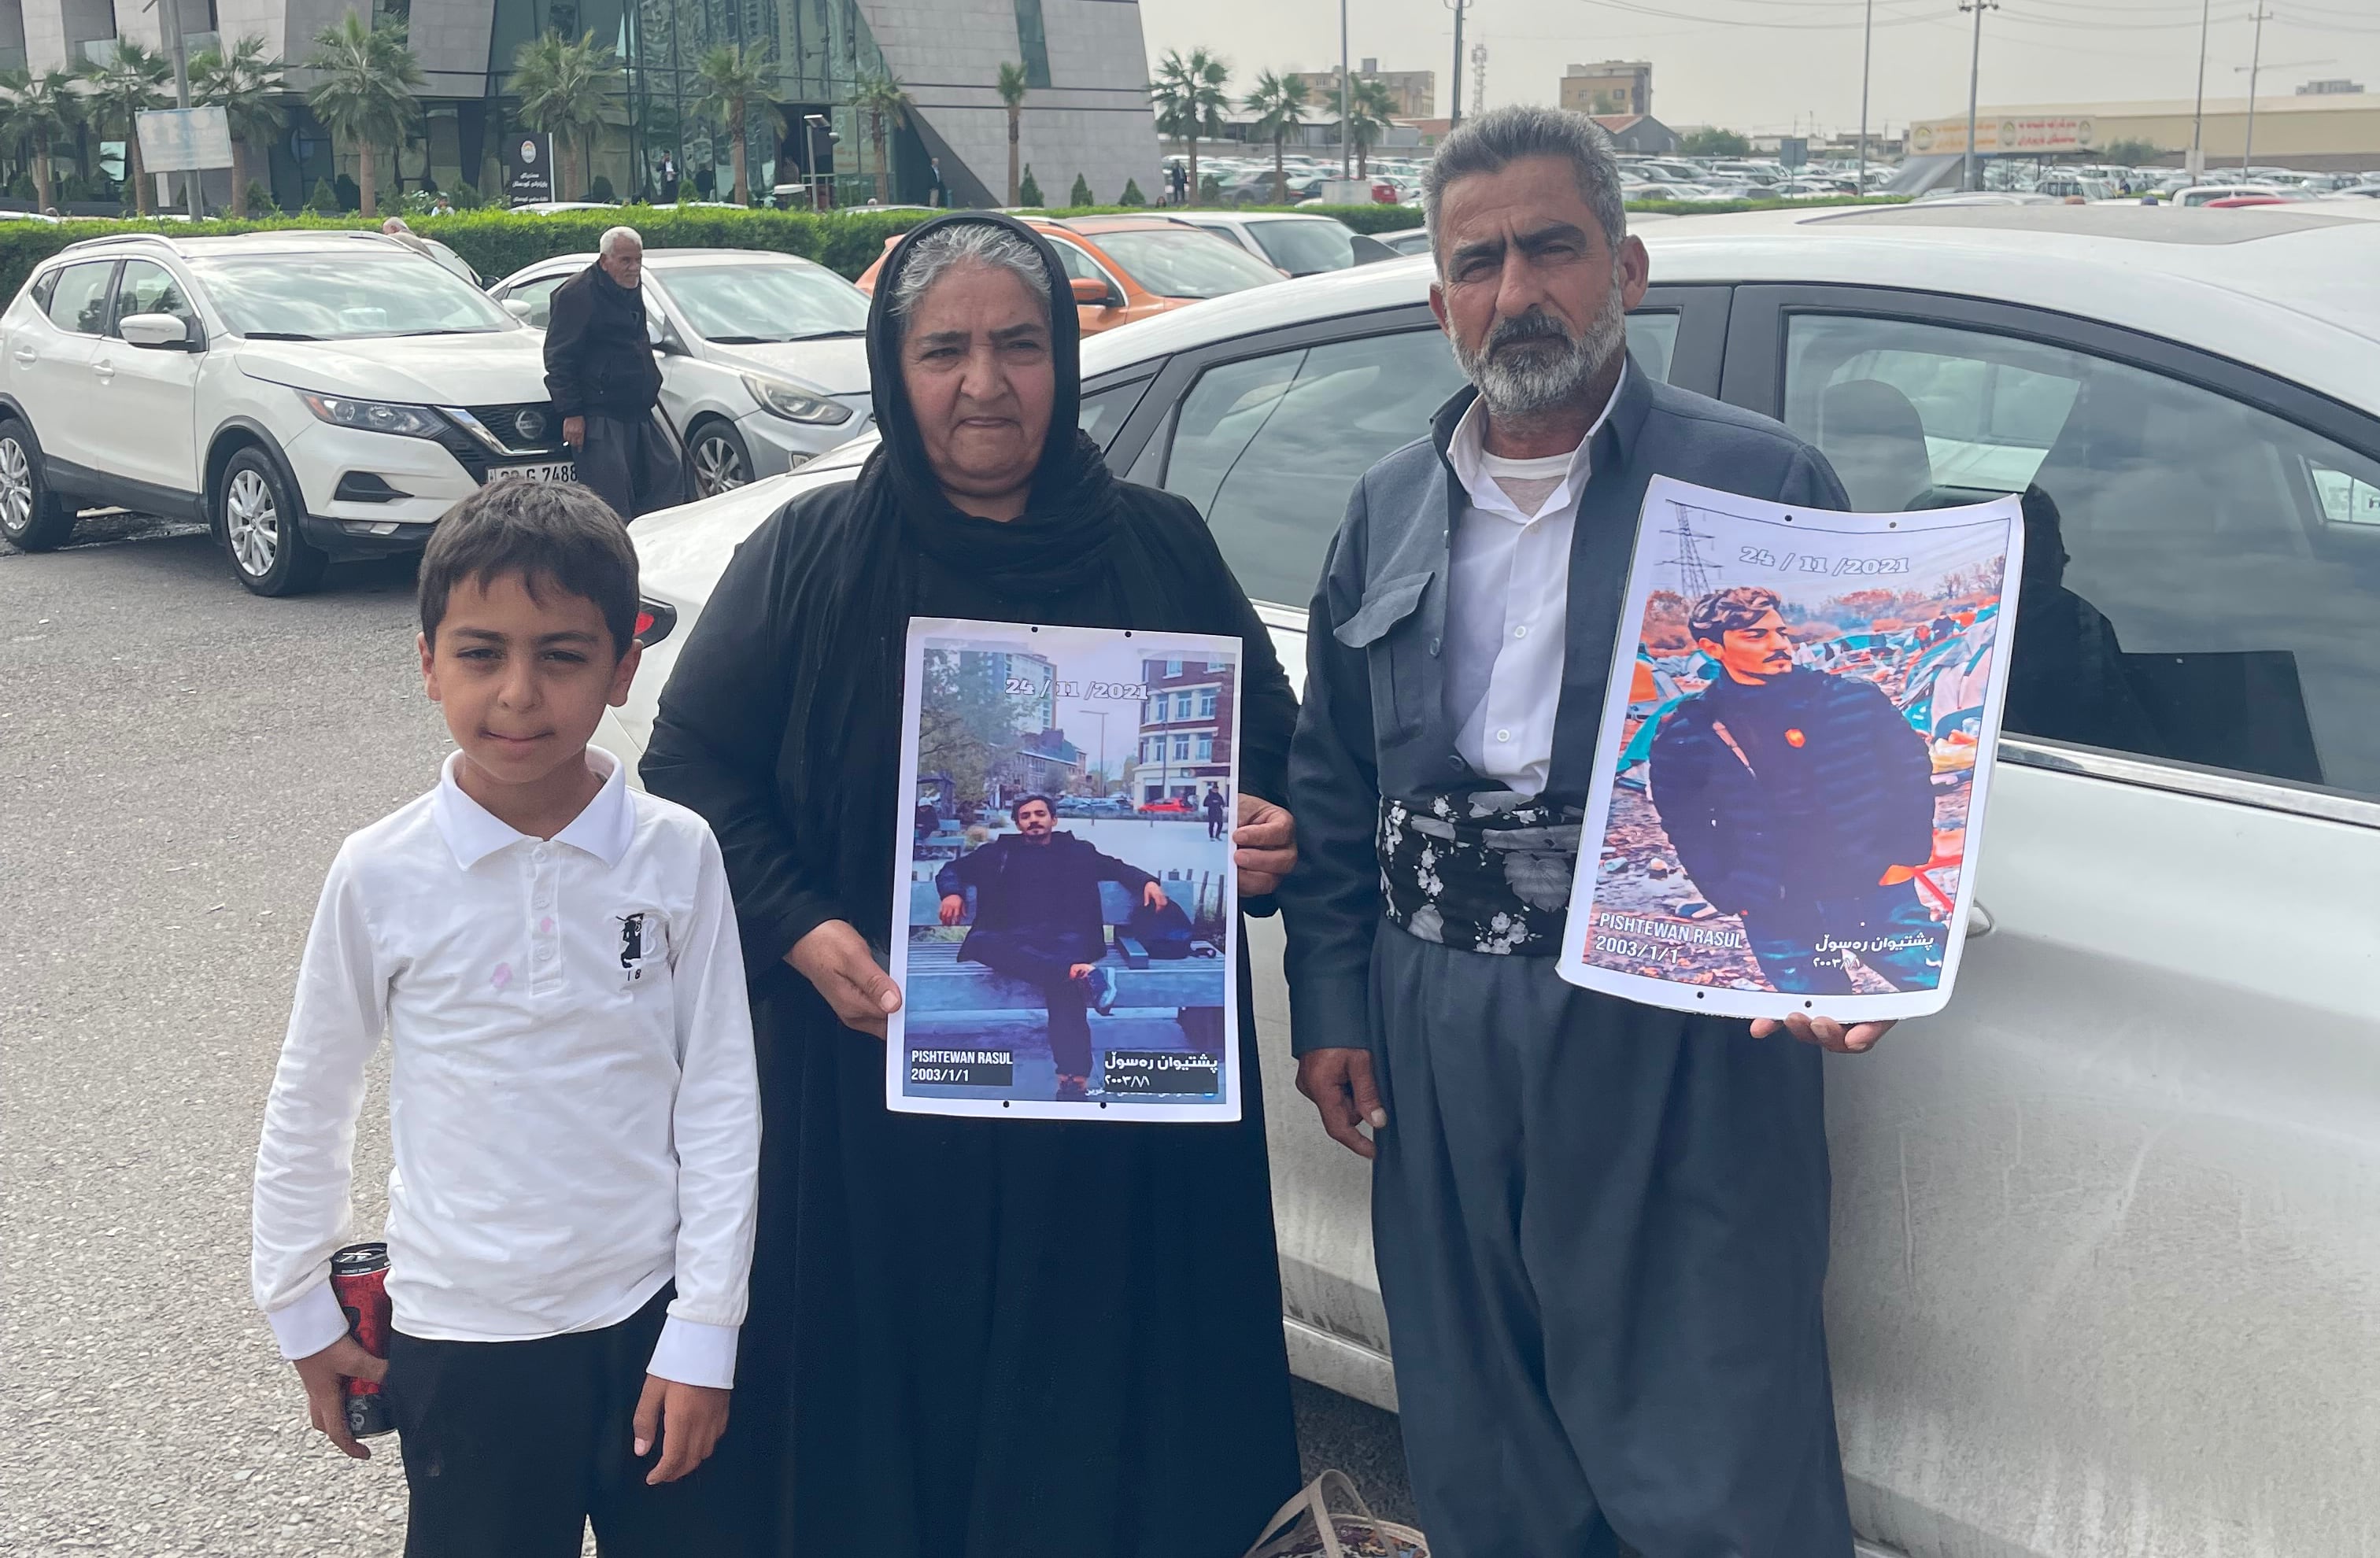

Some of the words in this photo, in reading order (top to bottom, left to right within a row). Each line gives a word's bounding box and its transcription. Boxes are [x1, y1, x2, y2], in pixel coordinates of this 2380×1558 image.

[542, 465, 577, 482] 7488
[1739, 546, 1776, 567] 24
[1779, 552, 1796, 571] /
[1799, 556, 1828, 574] 11
[1005, 678, 1035, 695] 24
[1040, 678, 1051, 699] /
[1055, 681, 1080, 697] 11
[1598, 912, 1690, 942] PISHTEWAN
[1693, 928, 1744, 949] RASUL
[1595, 935, 1681, 965] 2003/1/1
[911, 1050, 975, 1064] PISHTEWAN
[978, 1051, 1014, 1065] RASUL
[911, 1068, 970, 1082] 2003/1/1
